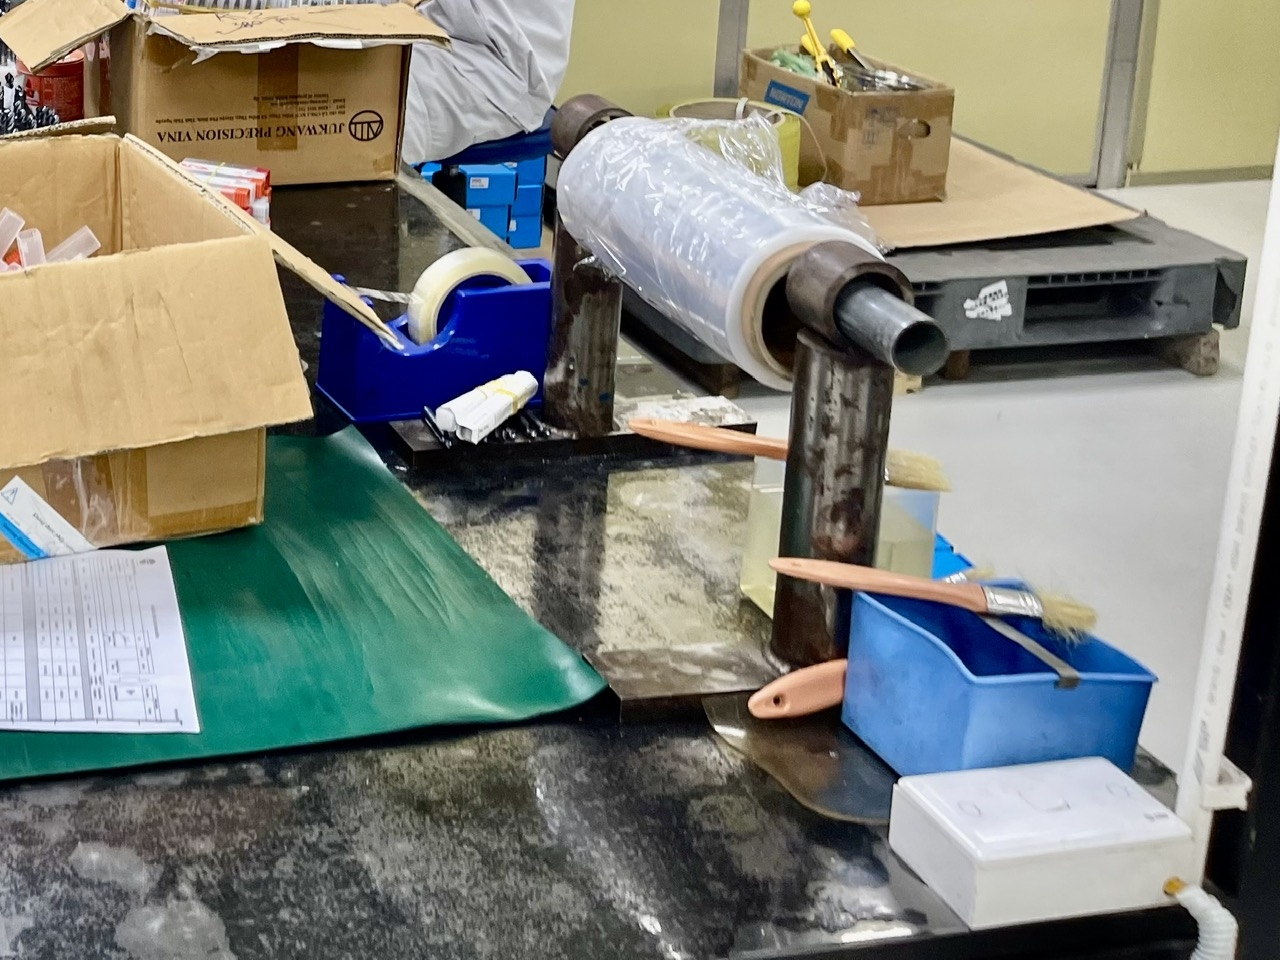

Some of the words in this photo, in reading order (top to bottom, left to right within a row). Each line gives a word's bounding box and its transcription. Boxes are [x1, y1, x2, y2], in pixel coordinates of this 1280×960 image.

[770, 87, 805, 109] NORTON
[156, 130, 193, 143] VINA
[196, 126, 272, 142] PRECISION
[276, 122, 346, 139] JUKWANG
